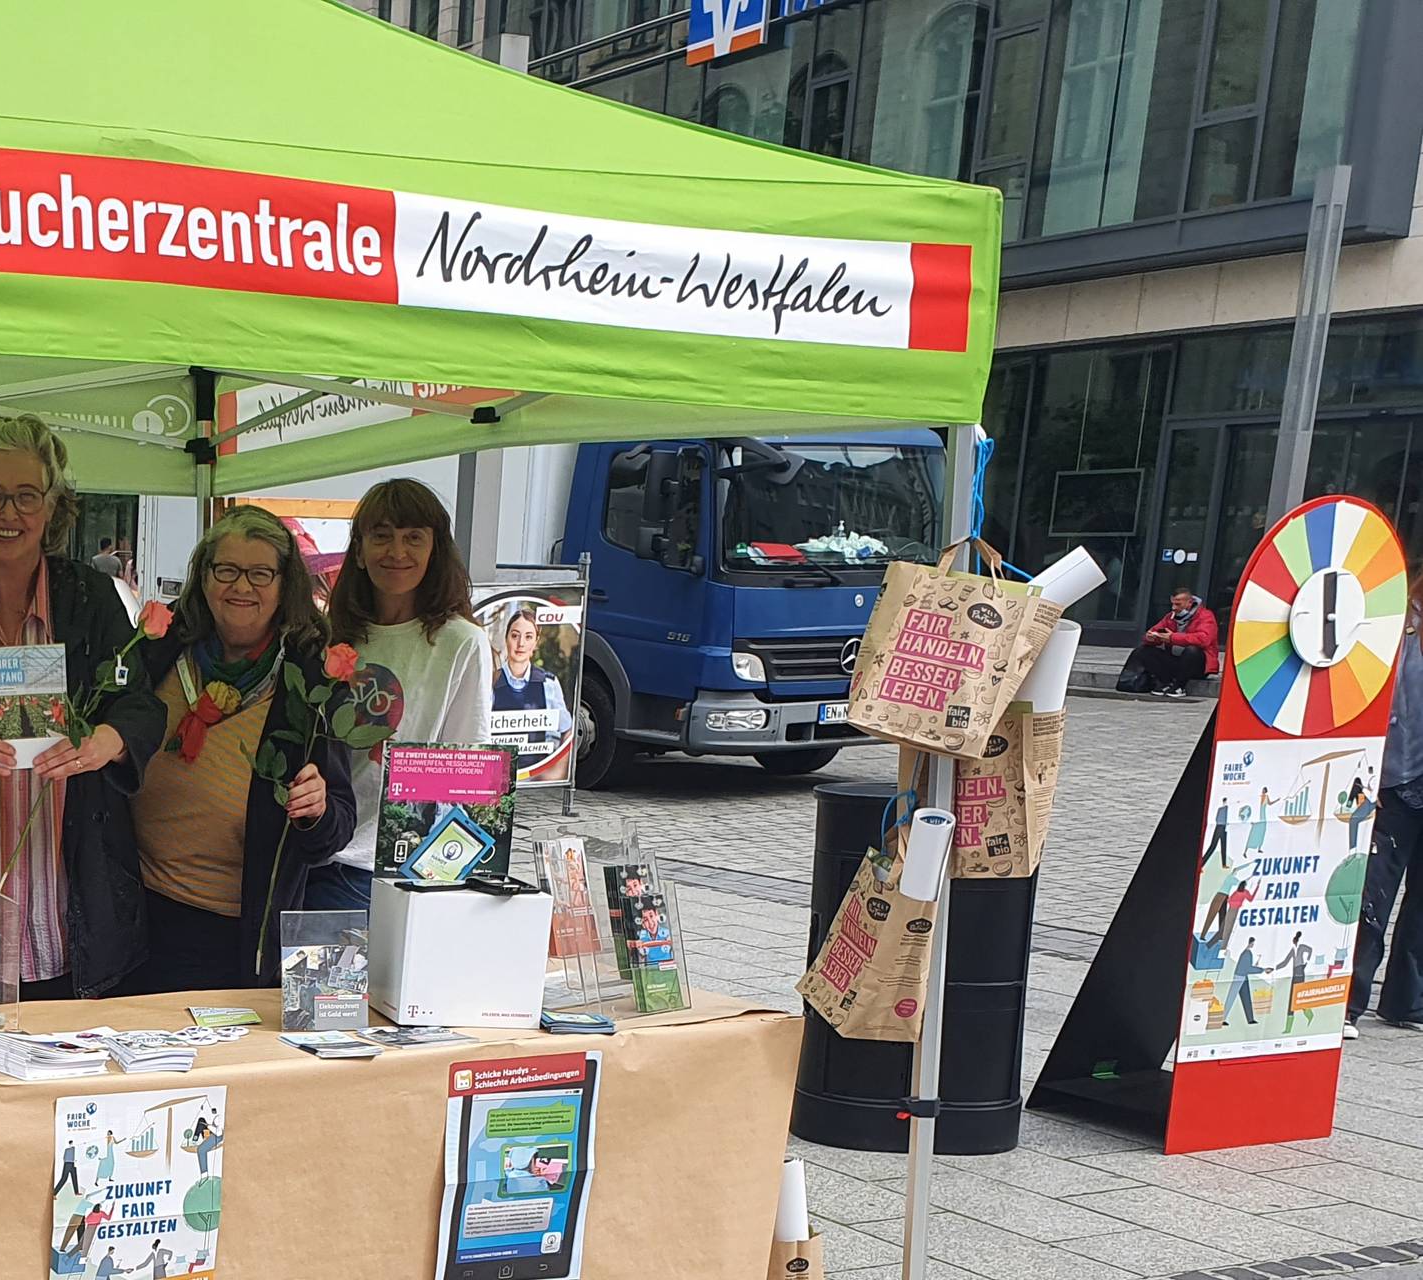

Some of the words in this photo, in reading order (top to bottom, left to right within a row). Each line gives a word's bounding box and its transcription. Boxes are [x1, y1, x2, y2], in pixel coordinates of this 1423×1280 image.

[417, 211, 892, 334] Nordrhein-Westfalen
[538, 613, 564, 622] CDU
[908, 611, 948, 636] FAIR
[899, 634, 984, 668] HANDELN.
[889, 658, 960, 689] BESSER
[880, 682, 943, 710] LEBEN.
[491, 714, 553, 729] icherheit.
[826, 707, 837, 719] EN
[952, 716, 969, 728] bio
[491, 737, 525, 745] CHLAND
[1223, 772, 1246, 780] WOCHE
[1224, 763, 1243, 772] FAIRE
[957, 777, 1004, 797] DELN.
[994, 843, 1010, 855] bio
[1252, 855, 1320, 876] ZUKUNFT
[1265, 882, 1299, 900] FAIR
[1239, 905, 1319, 927] GESTALTEN
[831, 940, 862, 974] BESSER
[328, 1010, 341, 1018] Gold
[475, 1069, 502, 1080] Schicke
[503, 1067, 529, 1077] Handys
[475, 1078, 509, 1089] Schlechte
[510, 1069, 580, 1086] Arbeitsbedingungen
[67, 1112, 86, 1120] FAIRE
[67, 1120, 91, 1128] WOCHE
[105, 1180, 172, 1199] ZUKUNFT
[121, 1201, 155, 1218] FAIR
[97, 1219, 177, 1240] GESTALTEN
